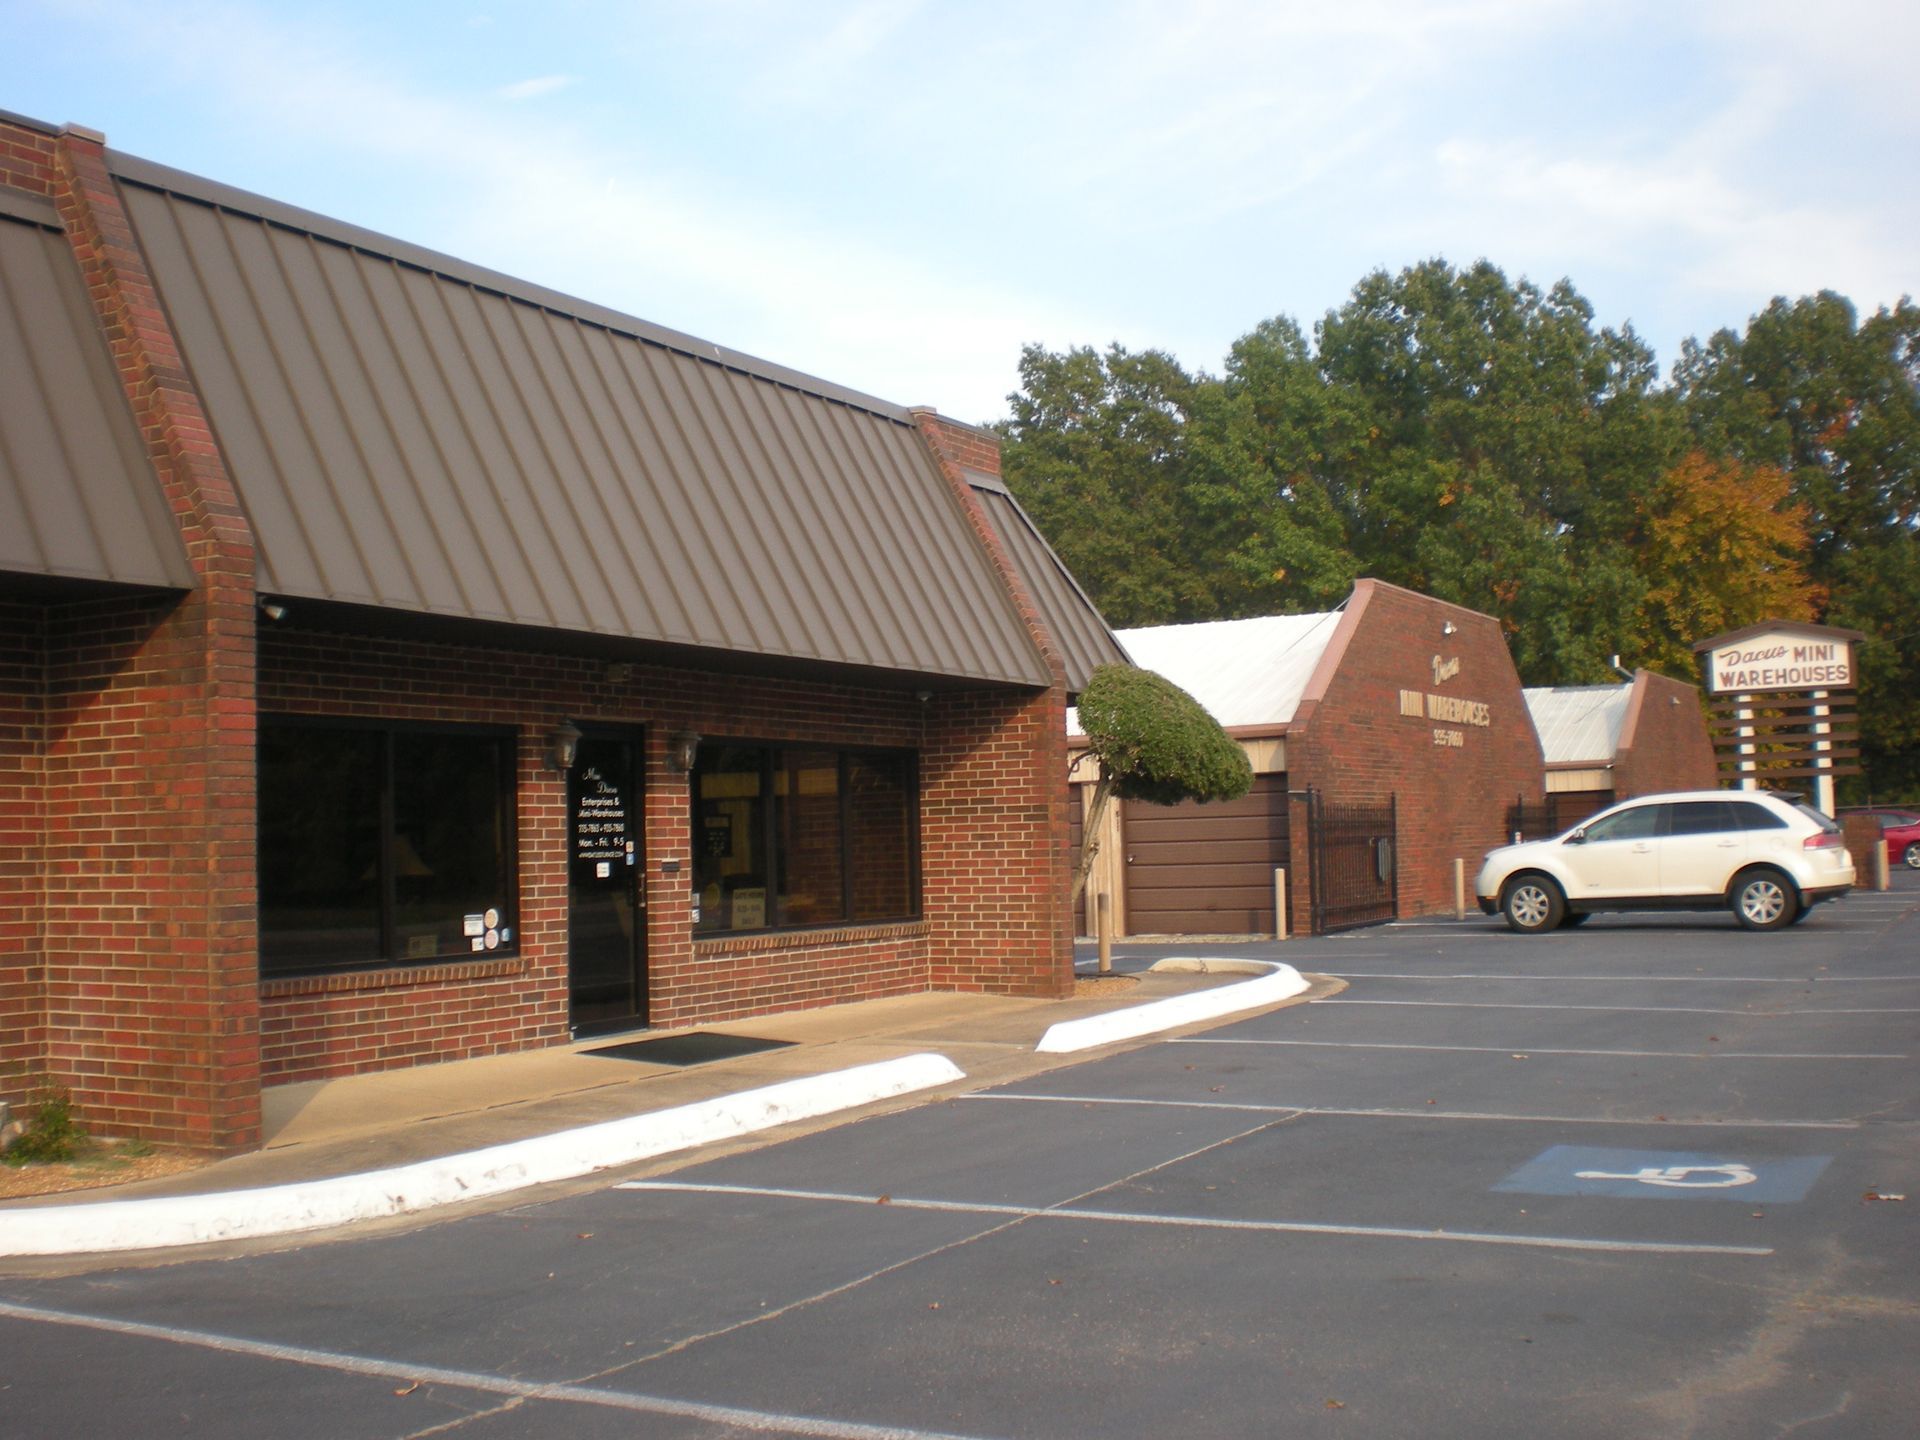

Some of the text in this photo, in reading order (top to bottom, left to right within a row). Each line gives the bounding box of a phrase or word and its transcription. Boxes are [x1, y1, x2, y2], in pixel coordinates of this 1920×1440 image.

[1719, 645, 1835, 667] Dacus MINI
[1720, 665, 1848, 688] WAREHOUSES
